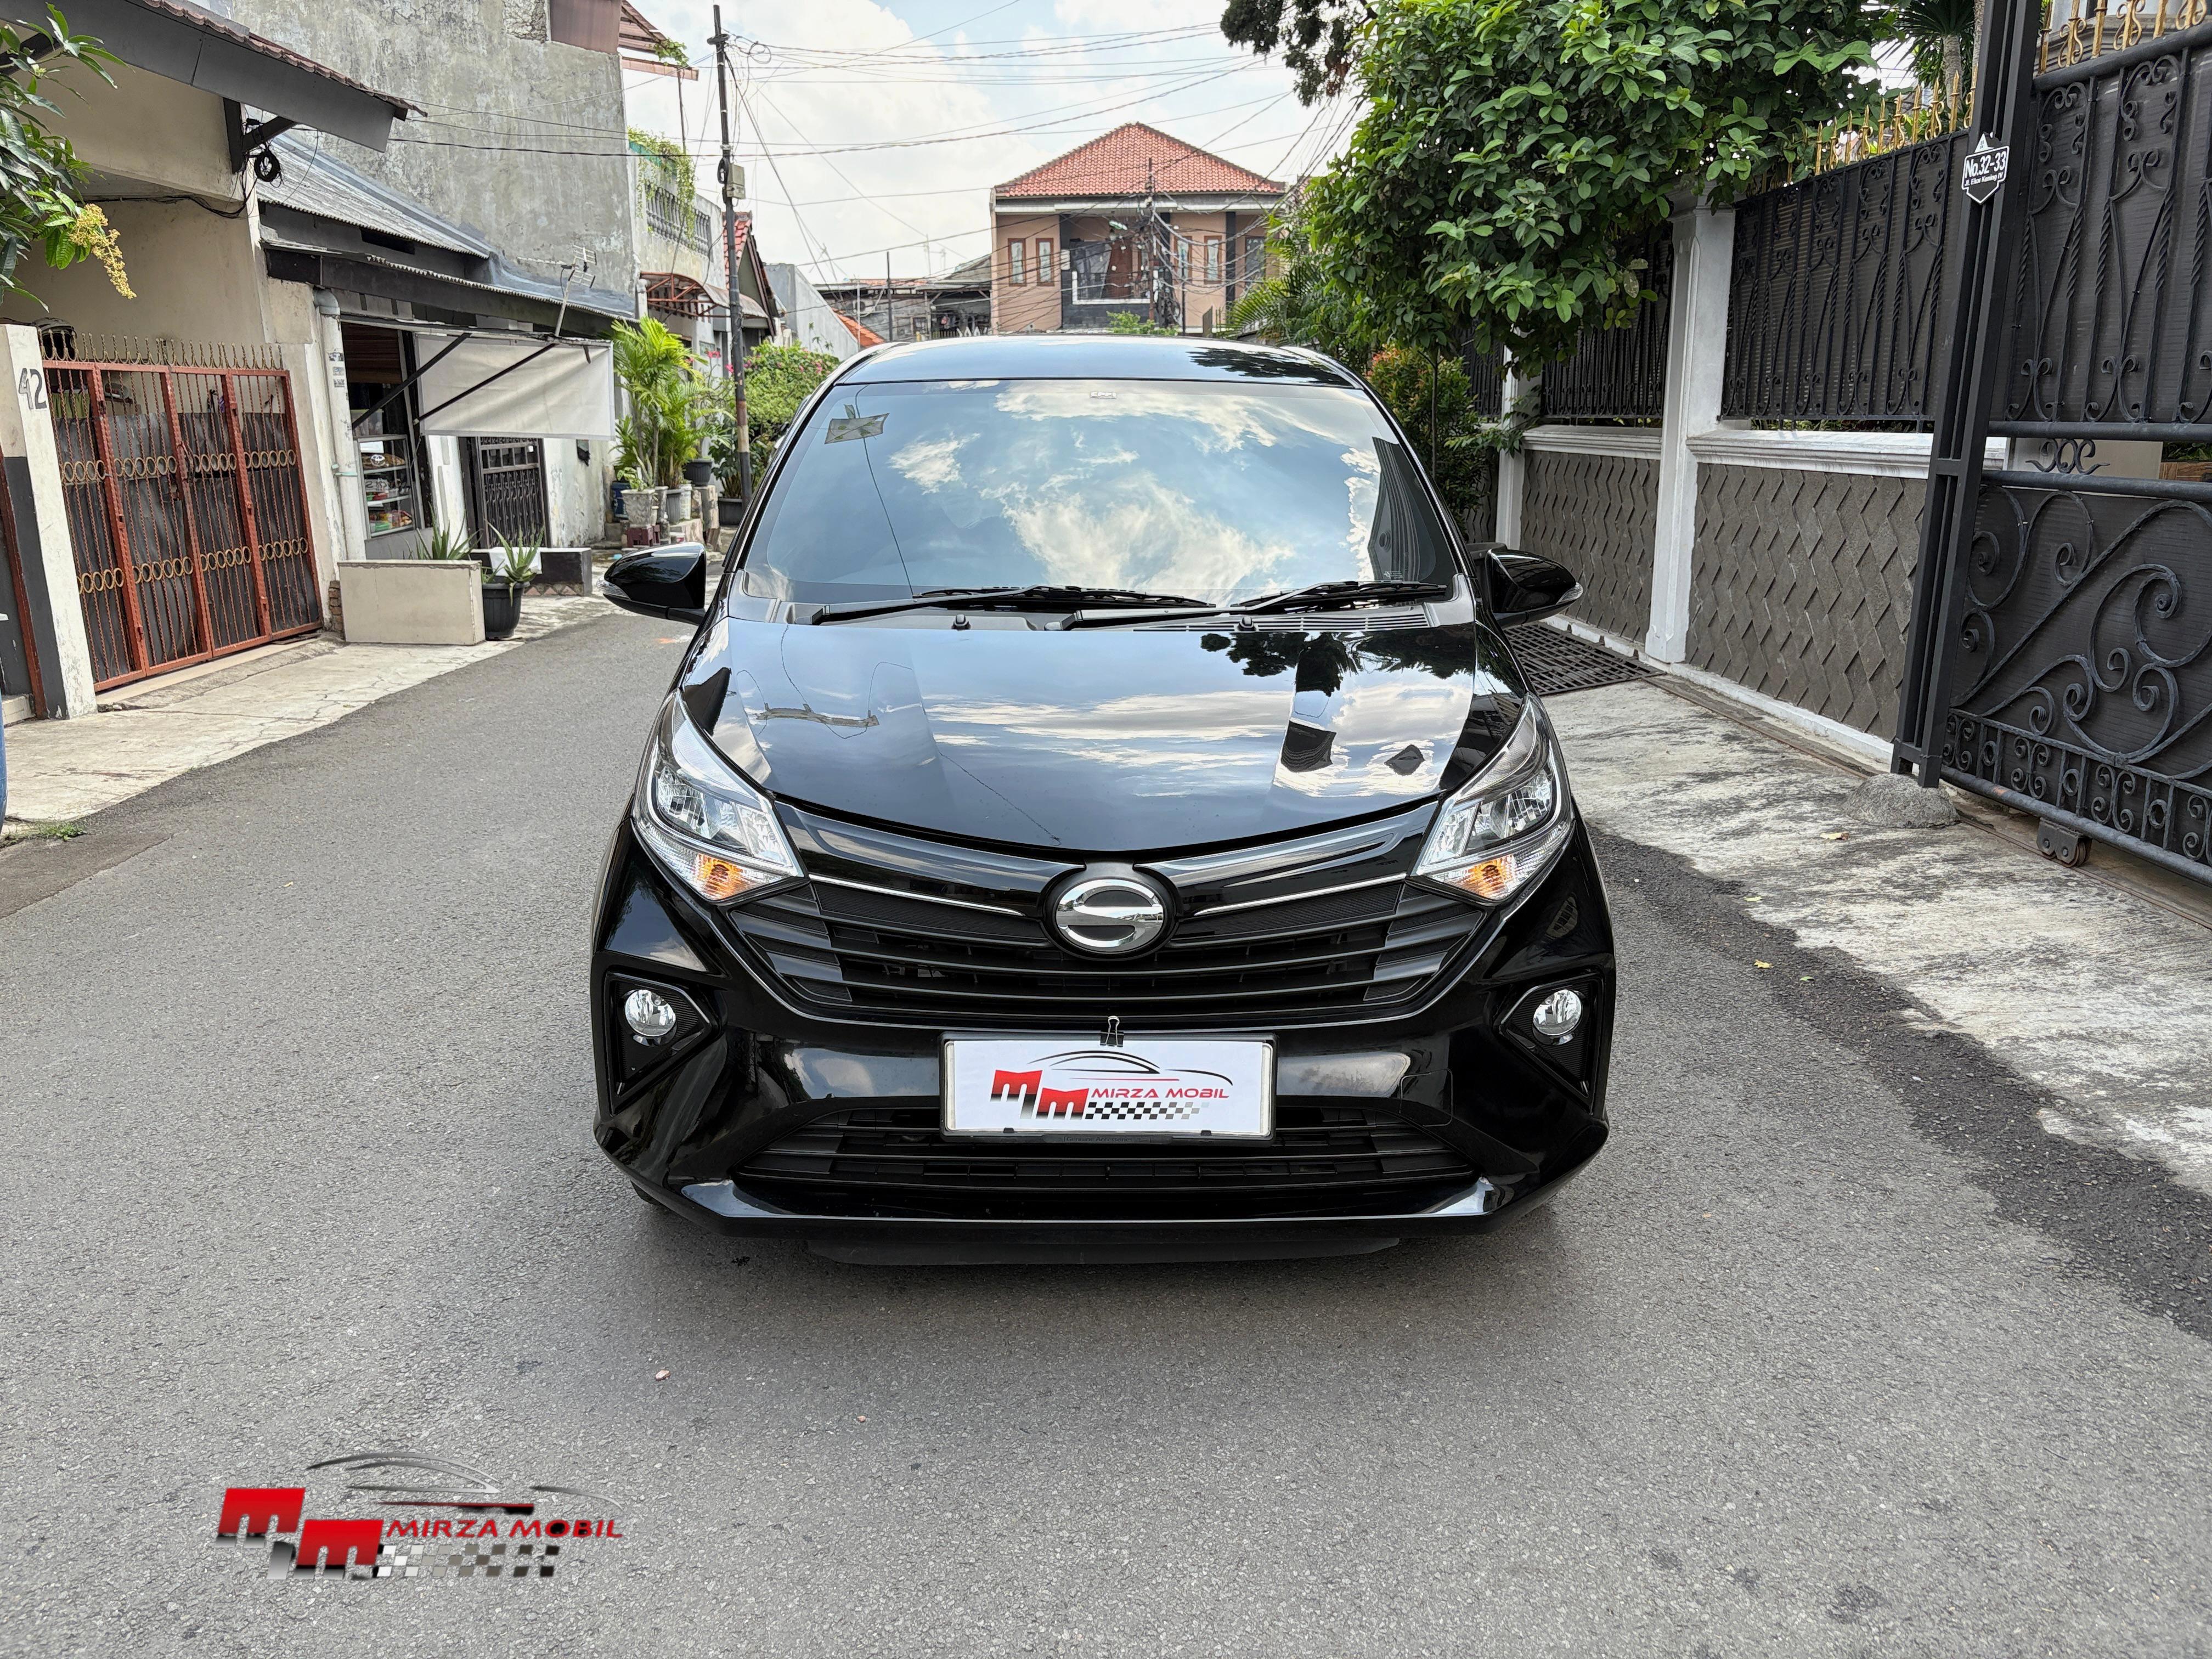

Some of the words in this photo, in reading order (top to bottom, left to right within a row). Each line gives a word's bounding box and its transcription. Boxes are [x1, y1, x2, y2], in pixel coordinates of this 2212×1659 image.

[1965, 151, 2006, 178] No.32-33
[19, 368, 47, 410] 42
[1091, 1088, 1159, 1098] MIRZA
[1165, 1088, 1229, 1098] MOBIL
